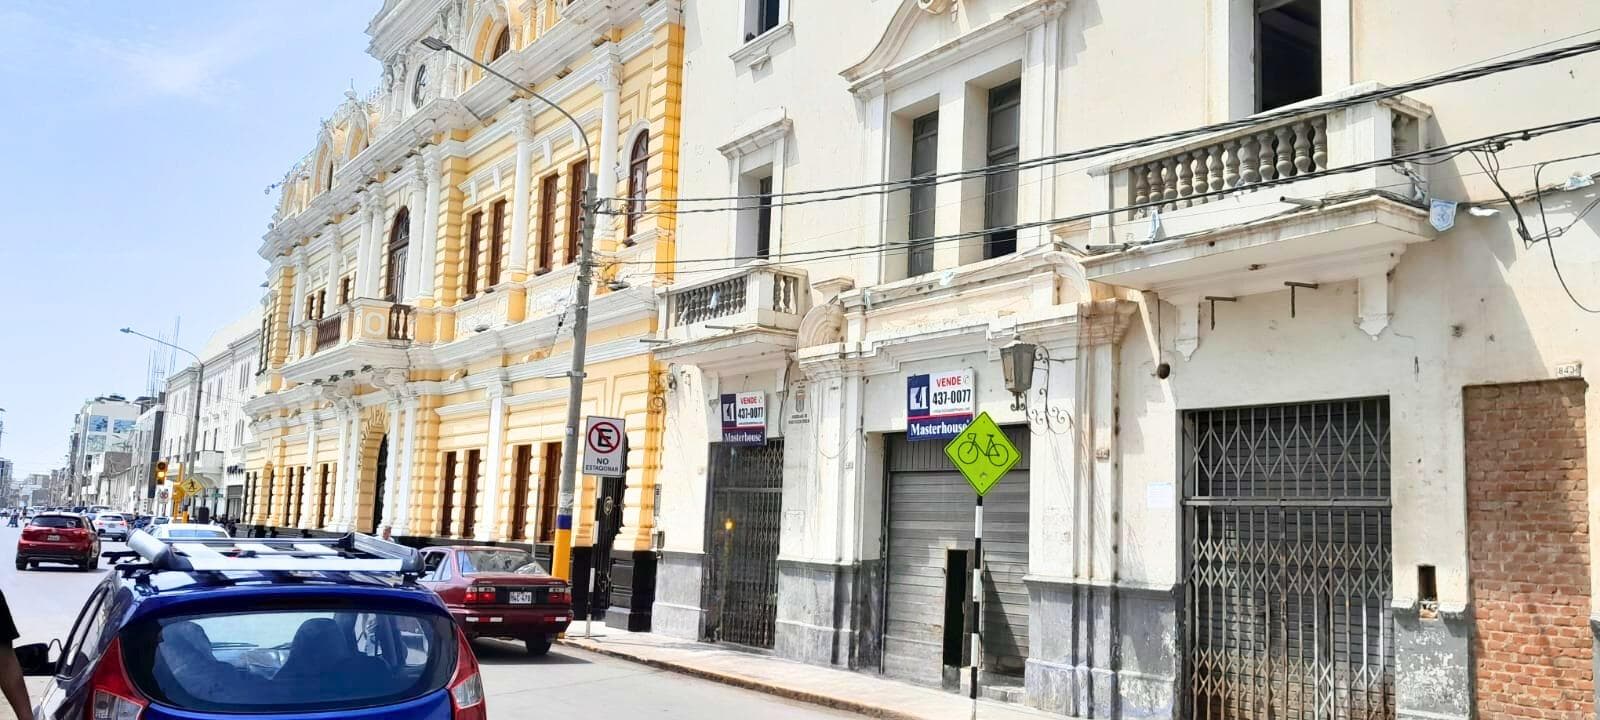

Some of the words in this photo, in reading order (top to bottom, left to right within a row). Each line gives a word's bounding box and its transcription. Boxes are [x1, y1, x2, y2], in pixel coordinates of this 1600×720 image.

[936, 376, 961, 387] VENDE
[741, 396, 757, 404] VENDE
[933, 389, 971, 405] 437-0077
[738, 407, 763, 418] 437-0077
[911, 421, 968, 435] Masterhouse
[724, 431, 762, 442] Masterhouse
[596, 457, 609, 465] NO
